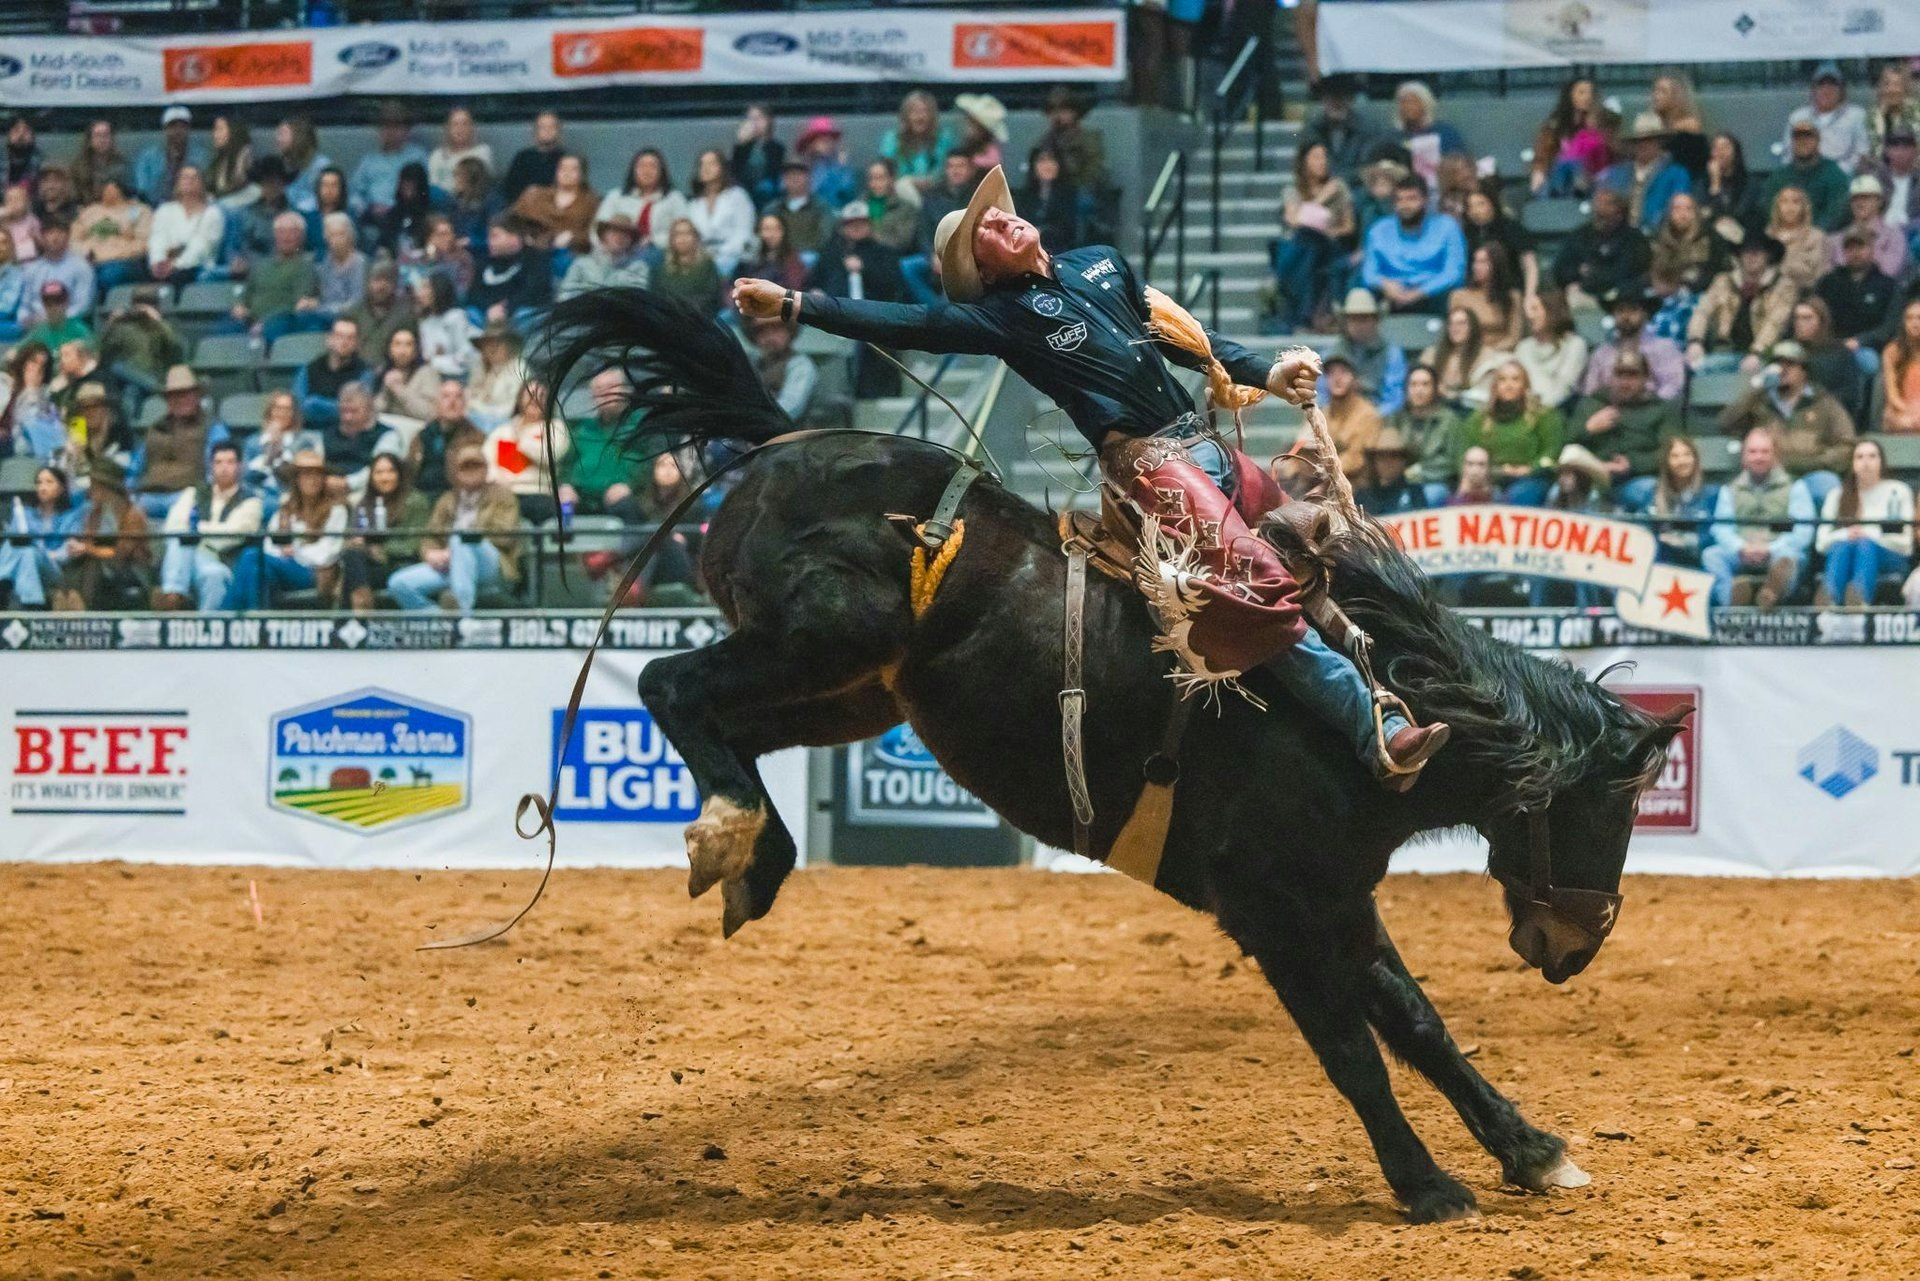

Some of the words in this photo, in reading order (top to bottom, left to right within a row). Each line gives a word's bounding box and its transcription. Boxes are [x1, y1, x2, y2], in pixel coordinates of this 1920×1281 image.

[30, 53, 124, 70] Mid-South
[30, 73, 71, 90] Ford
[1458, 513, 1635, 564] NATIONAL
[167, 619, 224, 647] HOLD
[229, 619, 260, 647] ON
[266, 619, 334, 647] TIGHT
[509, 619, 568, 647] HOLD
[610, 619, 681, 646] TIGHT
[1559, 617, 1592, 646] ON
[11, 783, 36, 800] IT'S
[40, 783, 92, 800] WHAT'S
[97, 783, 124, 800] FOR
